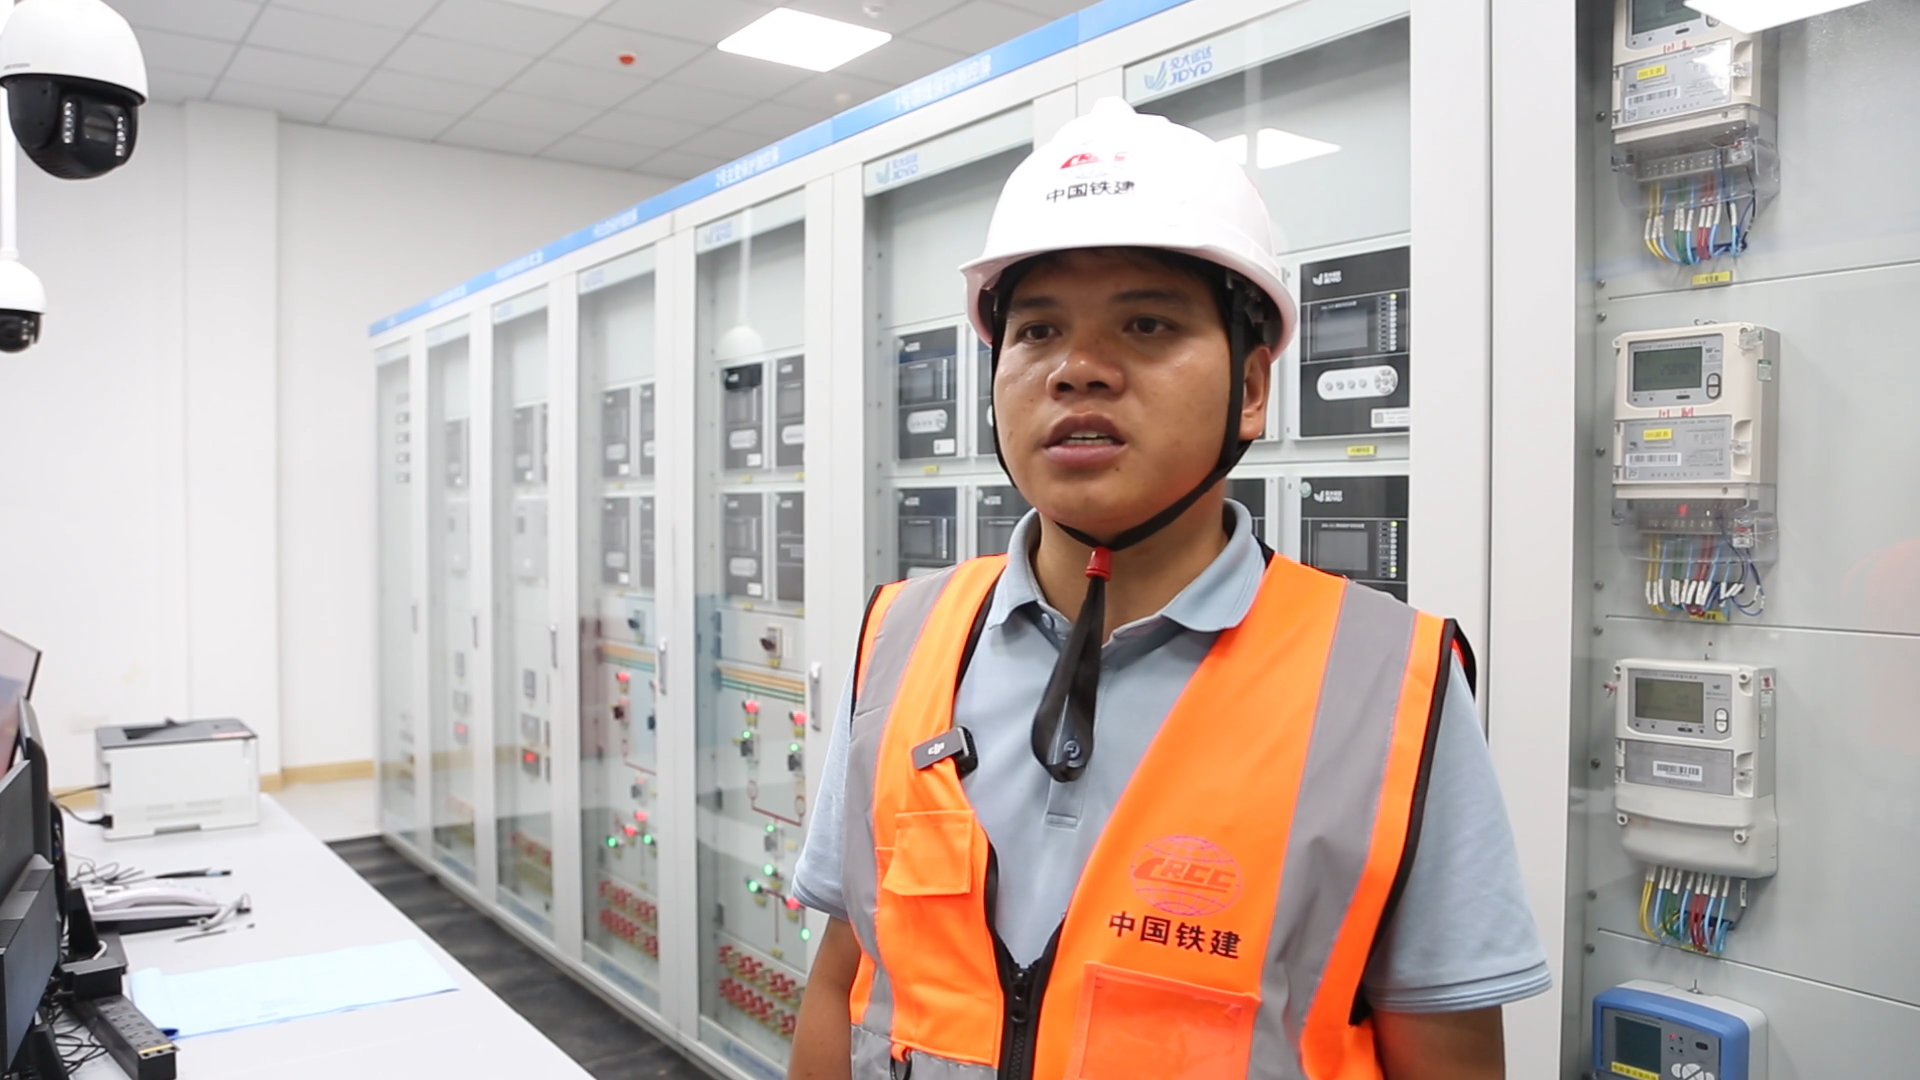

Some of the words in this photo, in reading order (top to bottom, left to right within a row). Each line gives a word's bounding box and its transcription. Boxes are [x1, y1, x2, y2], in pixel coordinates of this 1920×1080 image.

[1169, 60, 1213, 86] JDYD
[1046, 181, 1135, 203] 中国铁建
[1133, 858, 1236, 889] CRCC
[1108, 910, 1241, 959] 中国铁建
